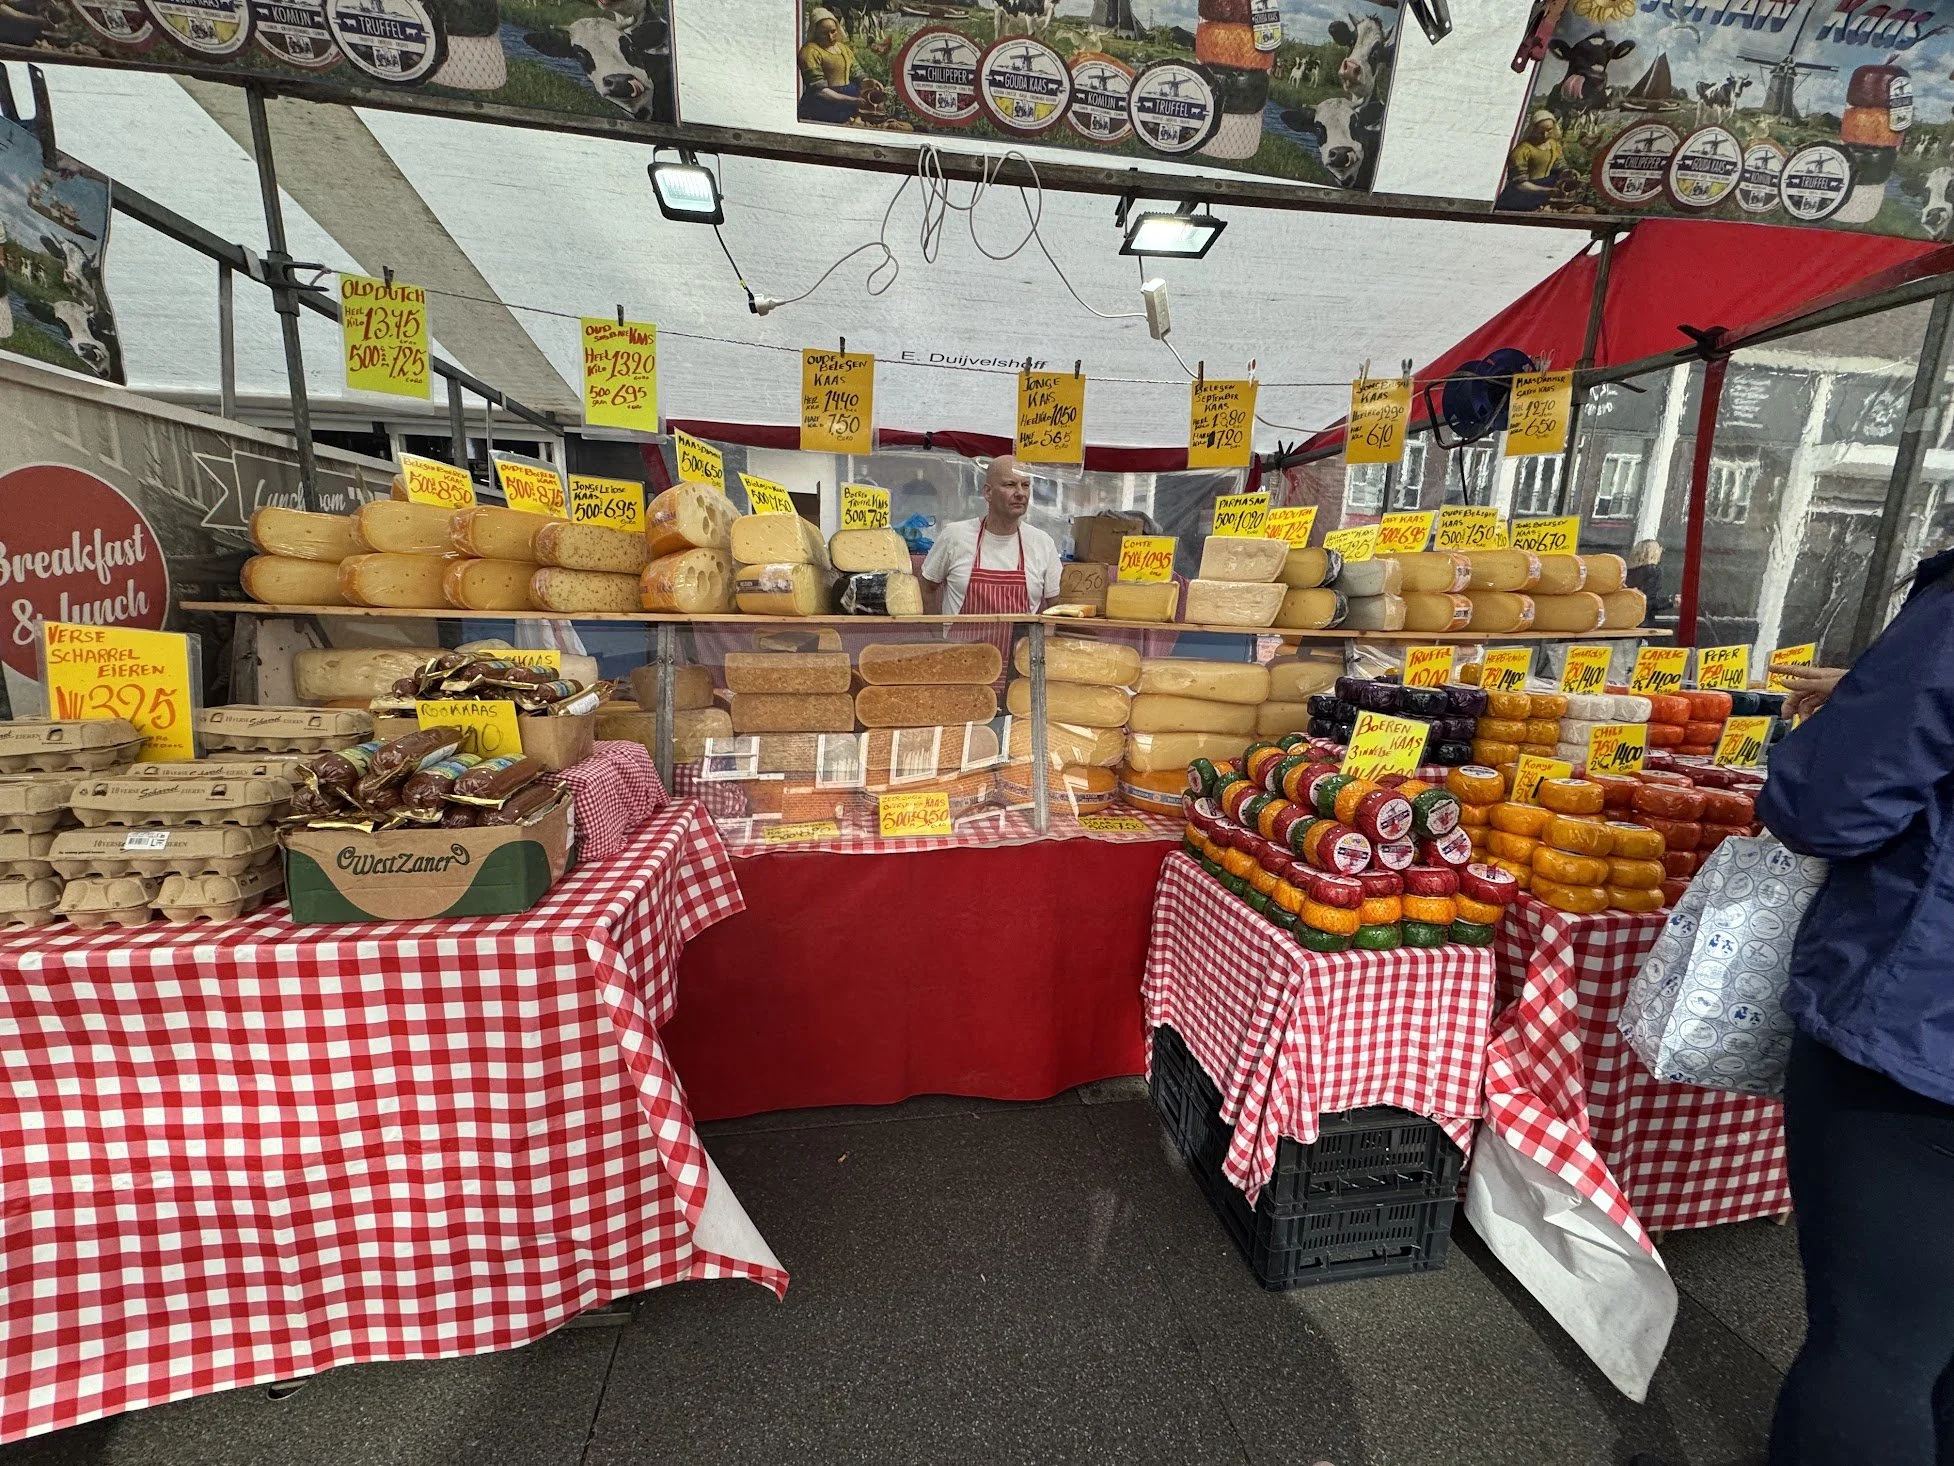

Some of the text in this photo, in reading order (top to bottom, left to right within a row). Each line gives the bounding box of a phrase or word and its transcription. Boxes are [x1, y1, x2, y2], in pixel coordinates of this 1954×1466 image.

[272, 6, 312, 26] KOMIJN
[359, 16, 405, 39] TRUFFEL
[927, 67, 968, 84] CHILIPEPER
[1004, 73, 1047, 94] GOUDA KAAS
[1087, 92, 1116, 109] KOMIJN
[1155, 99, 1189, 117] TRUFFEL
[1800, 176, 1829, 188] TRUFFEL
[341, 279, 426, 305] OLD DUTCH
[349, 343, 380, 372] 500
[901, 350, 922, 361] E.
[814, 373, 846, 386] KAAS
[589, 384, 611, 399] 500
[681, 449, 703, 473] 500
[506, 475, 533, 501] 500
[574, 502, 602, 522] 500
[845, 508, 864, 525] 500
[60, 578, 150, 626] lunch
[48, 624, 106, 645] VERSE
[48, 647, 140, 665] SCHARREL
[1704, 648, 1740, 665] PEPER
[421, 703, 498, 718] ROOKKAAS
[1390, 735, 1424, 751] KAAS
[882, 811, 912, 830] 500
